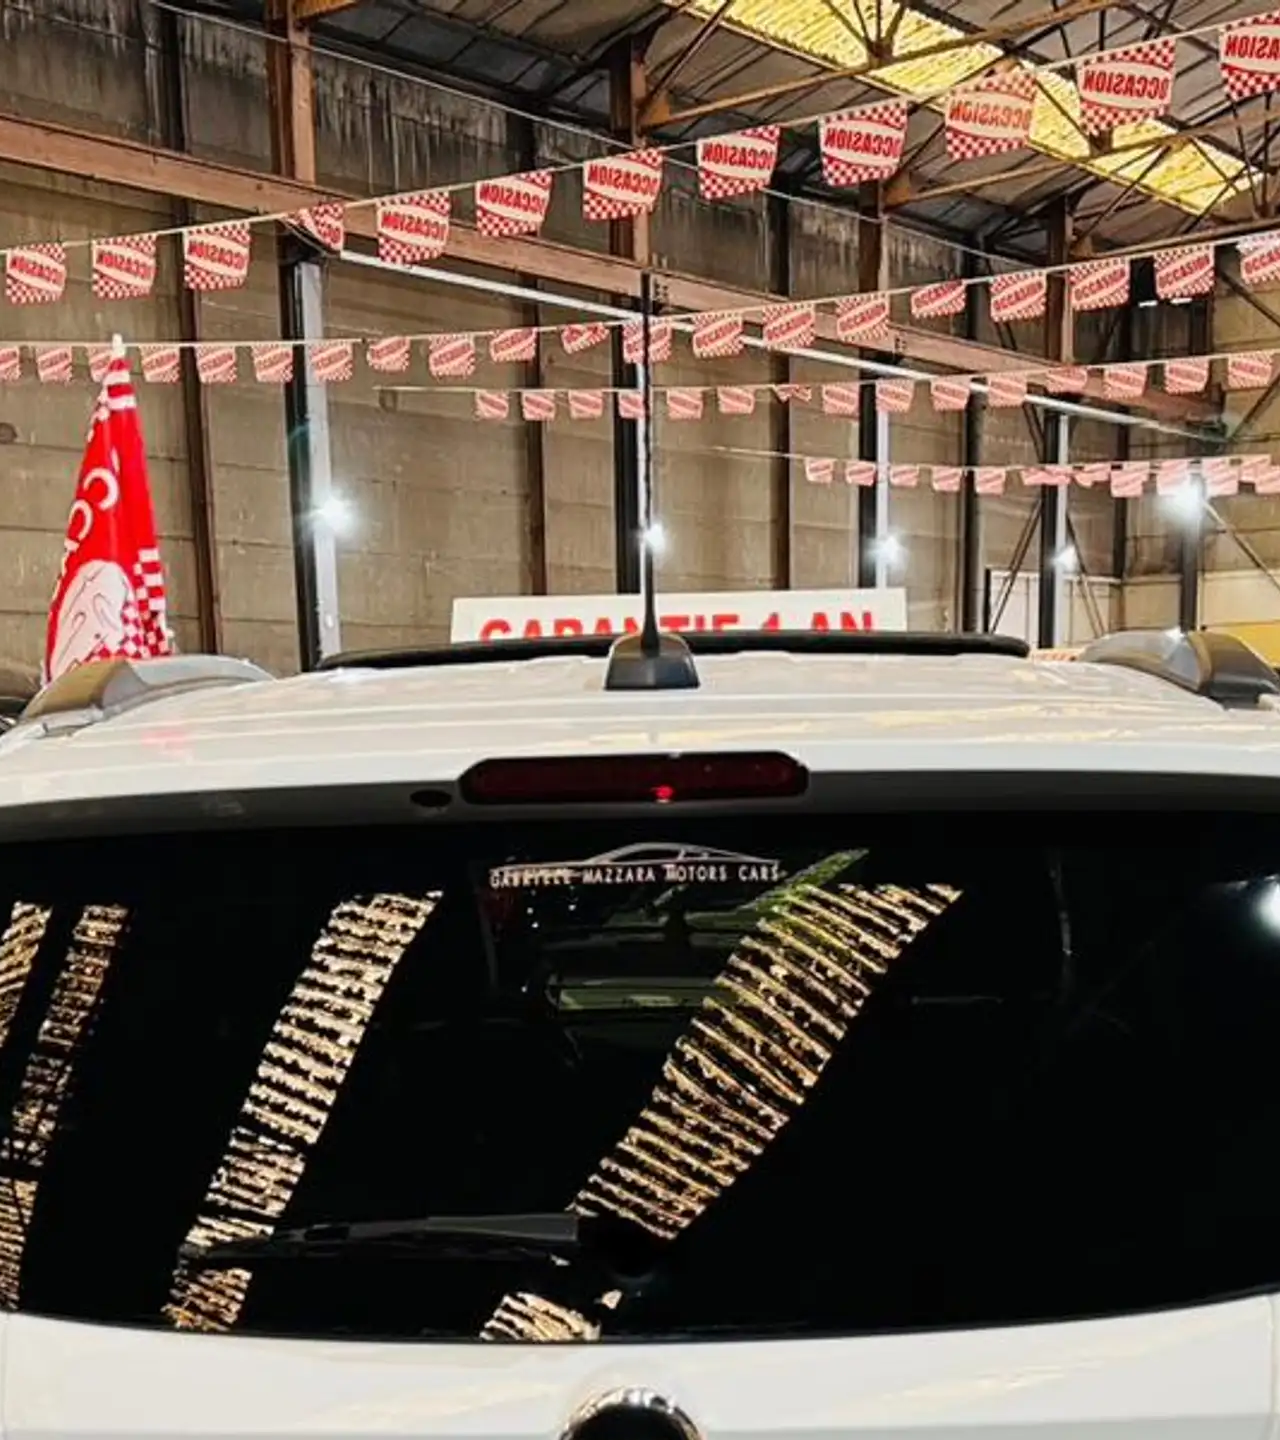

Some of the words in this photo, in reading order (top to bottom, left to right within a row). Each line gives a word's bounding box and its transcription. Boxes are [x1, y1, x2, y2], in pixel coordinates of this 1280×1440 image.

[1074, 268, 1127, 300] OCCASION
[1158, 255, 1211, 288] OCCASION
[993, 282, 1043, 311] OCCASION
[582, 867, 656, 884] MAZZARA
[662, 864, 727, 882] MOTORS
[738, 862, 780, 882] CARS
